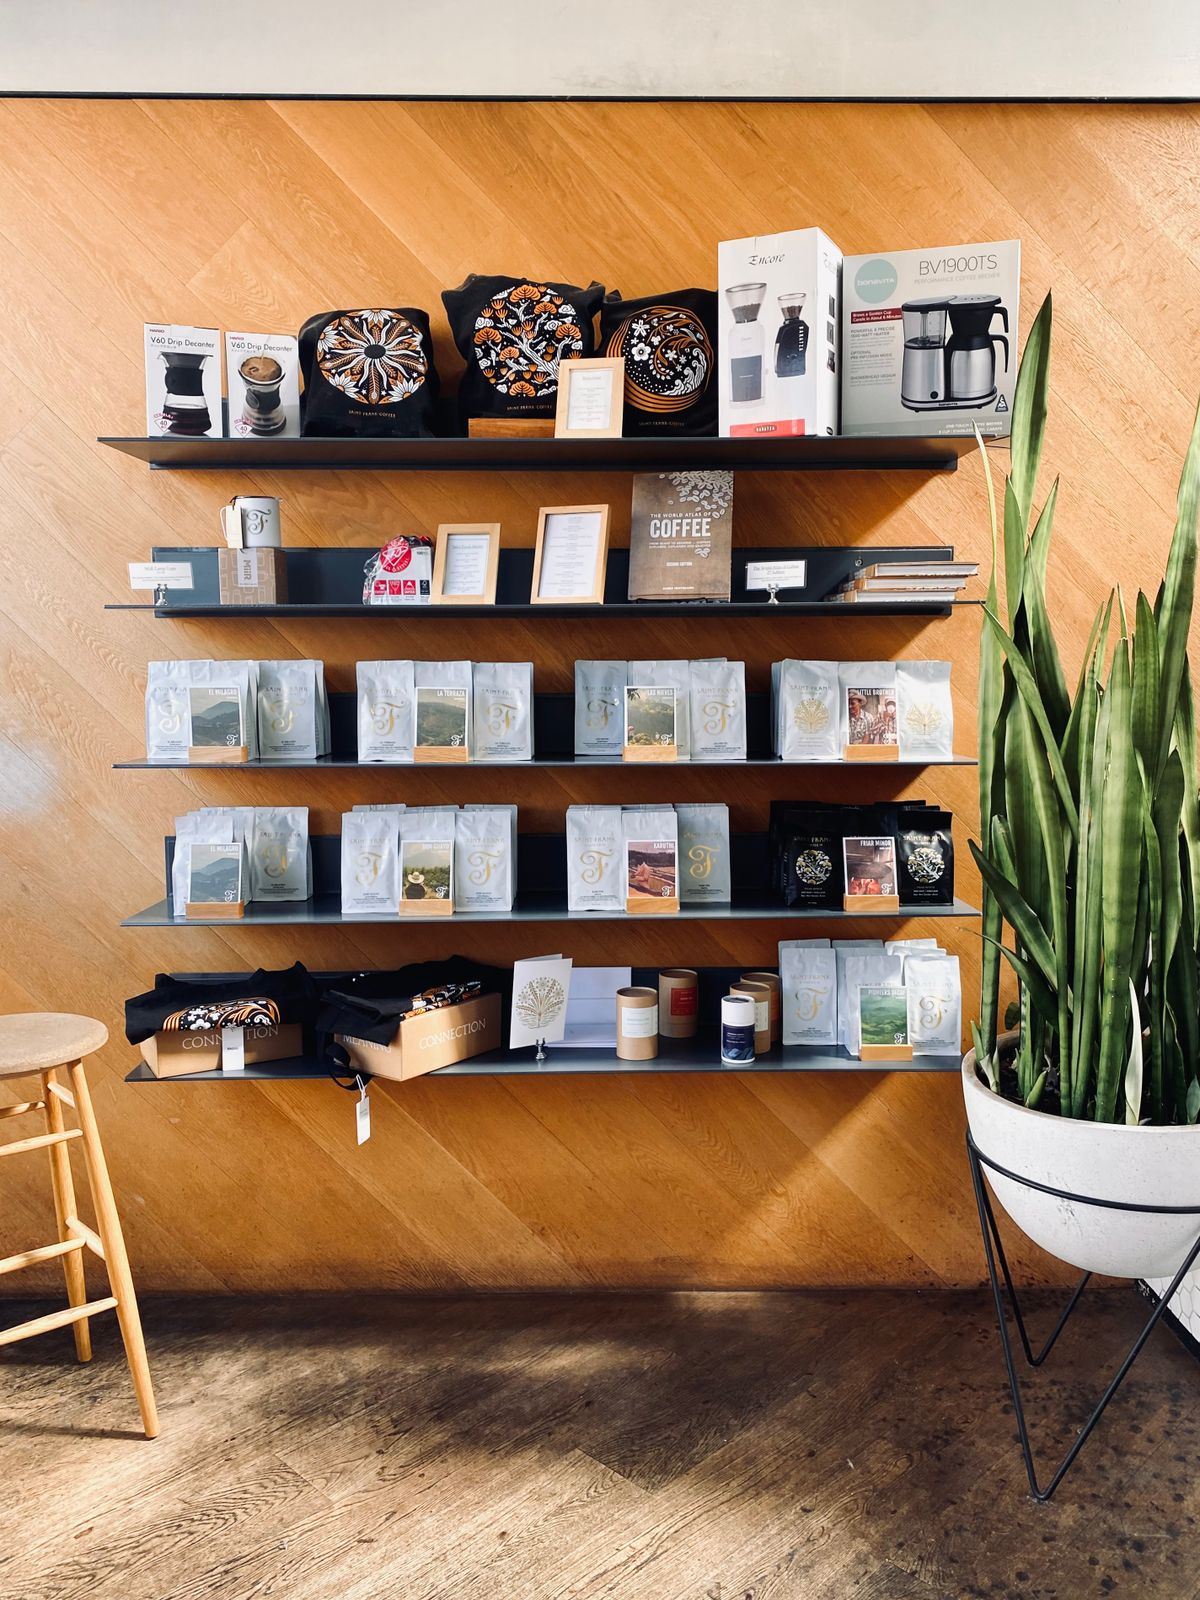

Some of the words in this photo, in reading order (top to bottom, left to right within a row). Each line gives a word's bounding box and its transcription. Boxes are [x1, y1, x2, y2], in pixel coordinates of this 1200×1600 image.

[748, 253, 786, 266] Encore
[919, 254, 998, 276] BV1900TS
[150, 336, 166, 345] V60
[167, 337, 183, 346] Drip
[184, 338, 215, 348] Decanter
[231, 342, 246, 350] V60
[247, 342, 262, 351] Drip
[263, 343, 293, 353] Decanter
[649, 518, 711, 538] COFFEE
[437, 689, 443, 697] LA
[444, 689, 465, 697] TERRAZA
[419, 1018, 488, 1051] CONNECTION
